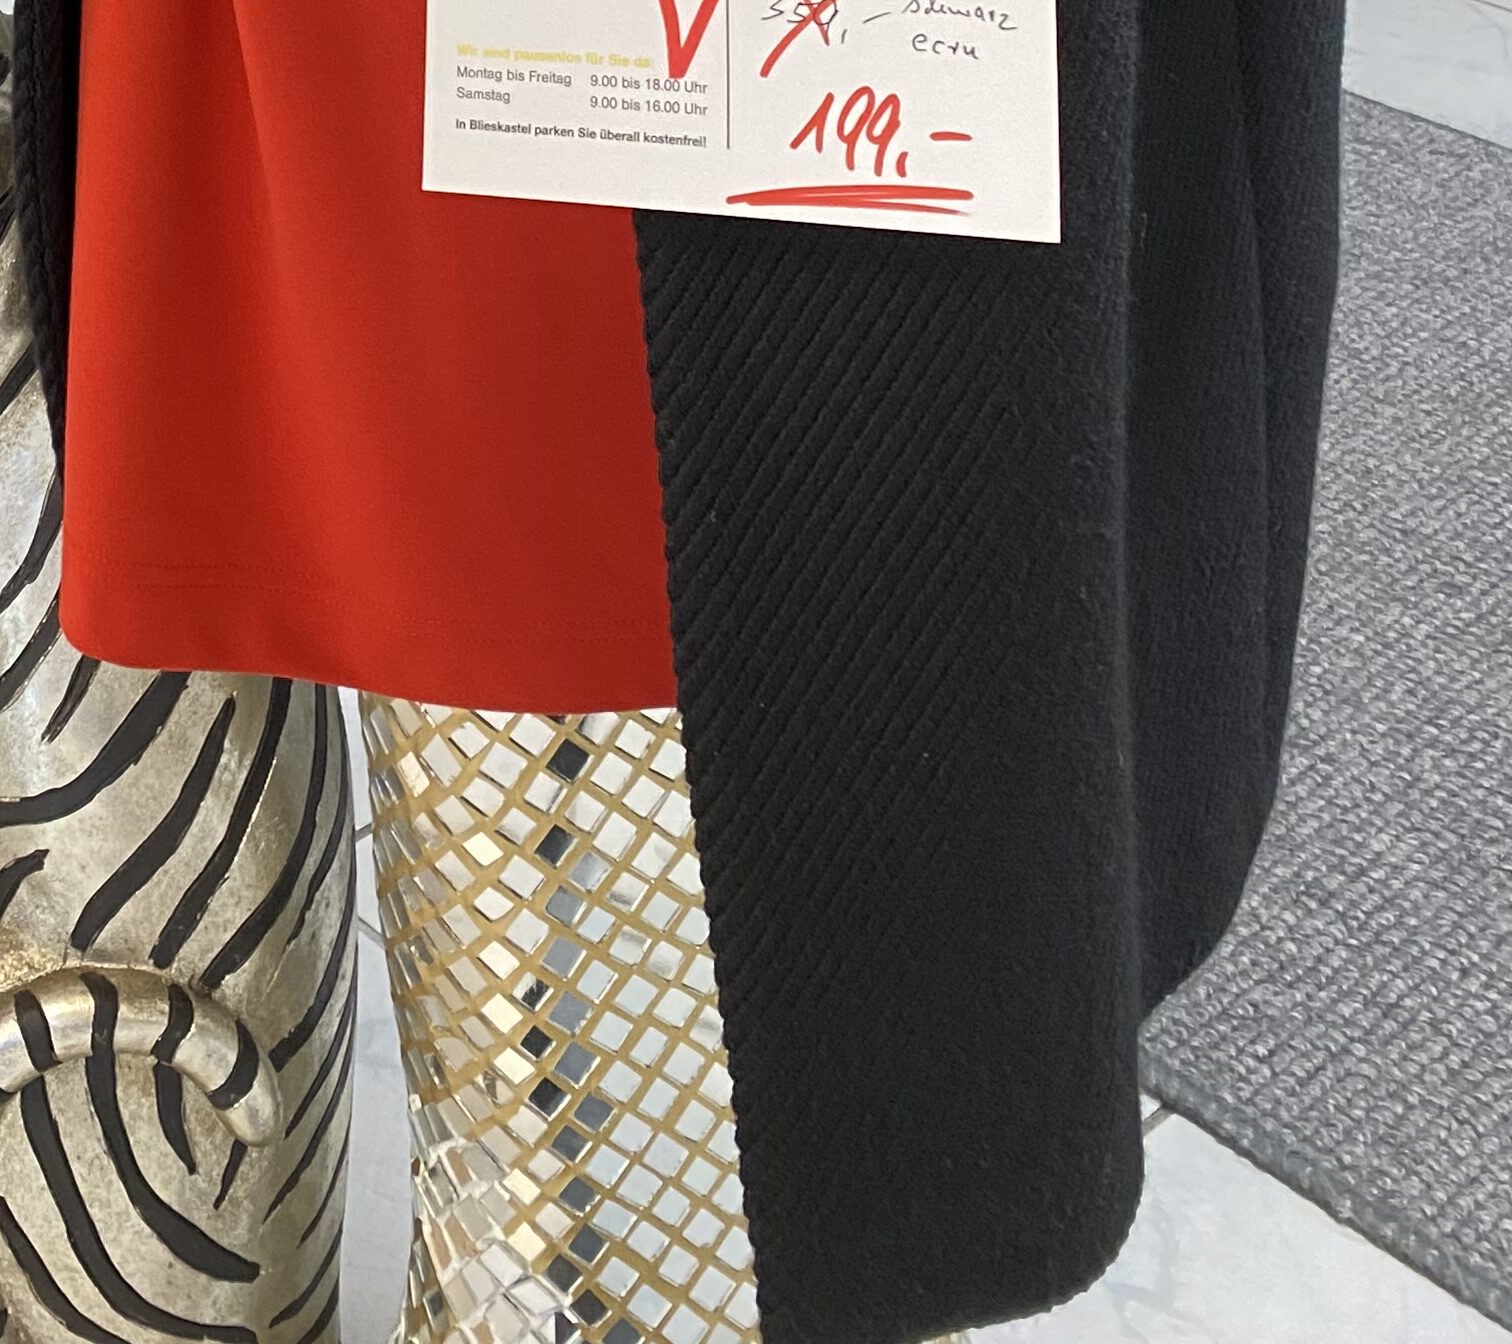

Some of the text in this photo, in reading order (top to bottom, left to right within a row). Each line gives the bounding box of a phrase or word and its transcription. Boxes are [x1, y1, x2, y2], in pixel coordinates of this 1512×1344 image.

[456, 65, 708, 94] Montag bis Freitag 9.00 bis 18.00 Uhr
[456, 86, 708, 116] Samstag 9.00 bis 16.00 Uhr
[455, 118, 708, 148] In Blieskastel parken Sie überall kostenfrei!
